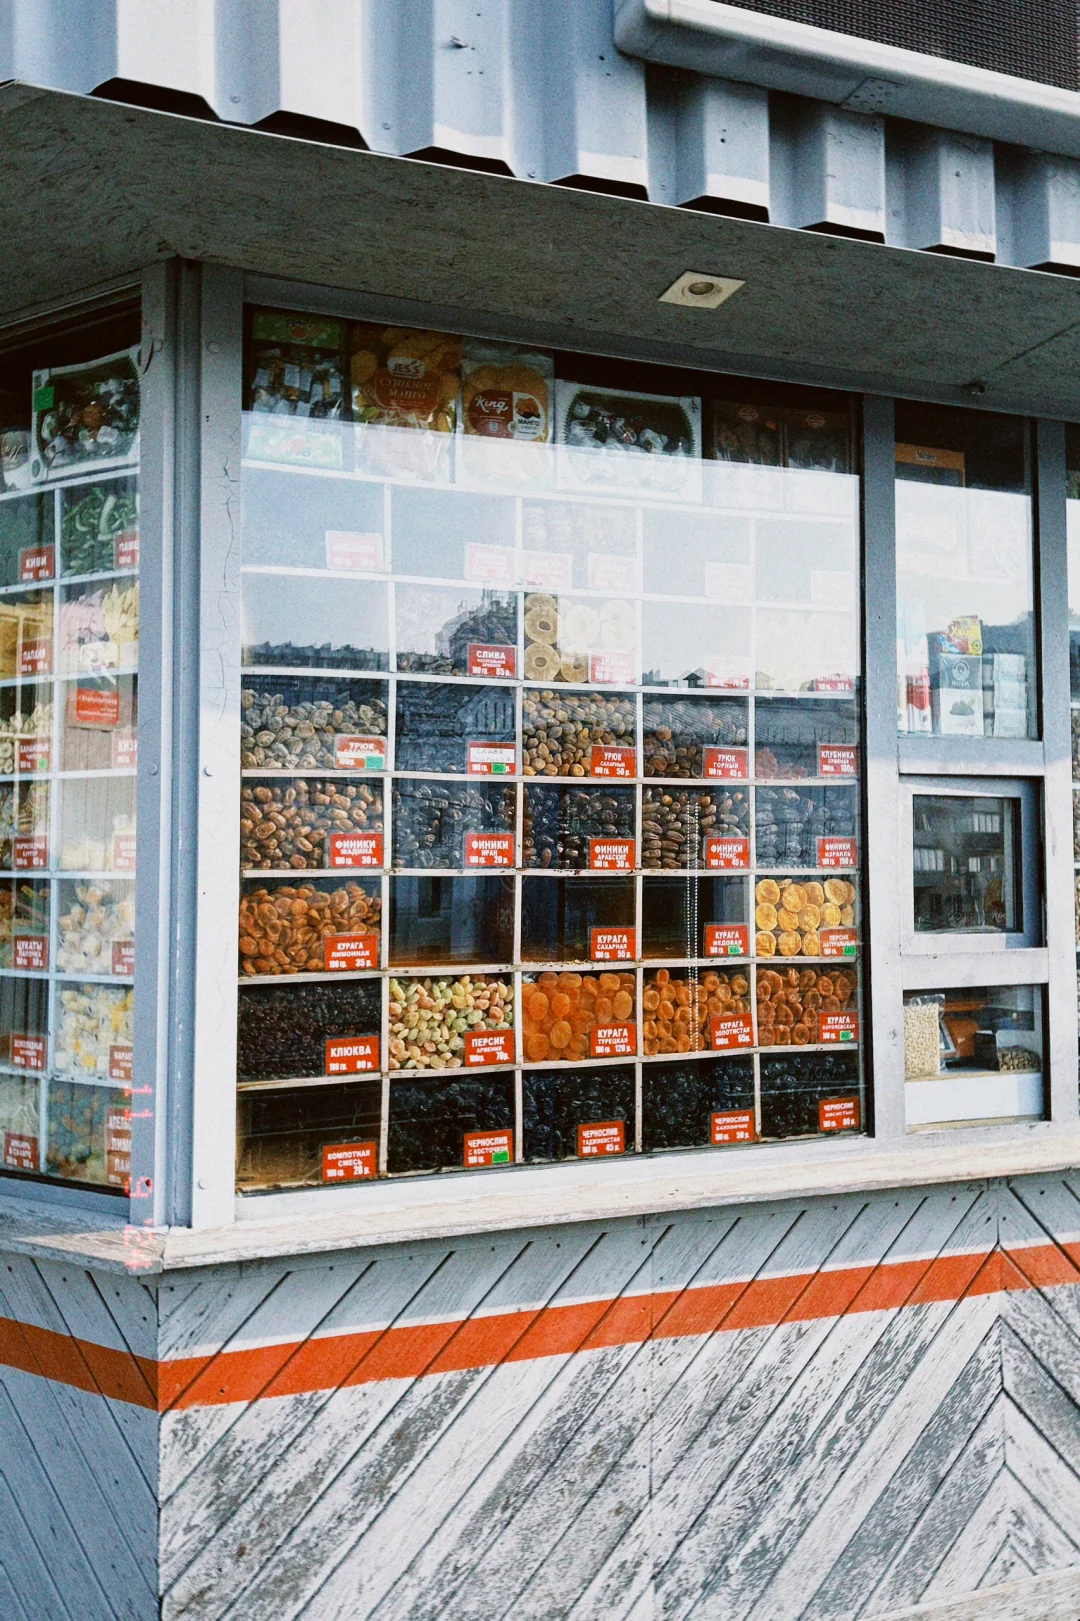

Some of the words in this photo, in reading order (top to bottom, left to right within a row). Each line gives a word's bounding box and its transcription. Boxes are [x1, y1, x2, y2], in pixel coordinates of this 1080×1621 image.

[389, 389, 425, 399] МАНГО
[475, 395, 509, 414] King
[518, 419, 540, 427] МАНГО
[26, 556, 47, 569] КИВИ
[476, 650, 506, 659] СЛИВА
[472, 666, 481, 674] 100
[349, 742, 375, 750] УРЮК
[604, 752, 622, 762] УРЮК
[718, 754, 736, 762] УРЮК
[821, 750, 855, 759] КЛУБНИКА
[335, 839, 376, 850] ФИНИКИ
[471, 840, 509, 850] ФИНИКИ
[710, 844, 743, 853] ФИНИКИ
[825, 843, 851, 851] ФИНИКИ
[481, 849, 498, 857] ИРАН
[594, 845, 629, 854] ФИНИКИ
[335, 857, 345, 865] 100
[469, 856, 479, 864] 100
[597, 853, 626, 861] АРАБСКИЕ
[594, 860, 602, 868] 100
[597, 934, 628, 943] КУРАГА
[715, 931, 740, 939] КУРАГА
[16, 941, 42, 951] ЦУКАТЫ
[337, 942, 364, 950] КУРАГА
[709, 946, 718, 954] 100
[331, 950, 370, 958] ЛИМОННАЯ
[595, 951, 604, 959] 100
[329, 960, 339, 968] 100
[720, 1020, 744, 1030] КУРАГА
[827, 1016, 851, 1025] КУРАГА
[597, 1028, 629, 1038] КУРАГА
[714, 1027, 751, 1037] ЗОЛОТИСТАЯ
[471, 1036, 505, 1048] ПЕРСИК
[597, 1037, 629, 1045] ТУРЕЦКАЯ
[330, 1045, 372, 1058] КЛЮКВА
[595, 1046, 605, 1054] 100
[329, 1063, 340, 1071] 100
[823, 1102, 854, 1112] ЧЕРНОСЛИВ
[714, 1115, 750, 1124] ЧЕРНОСЛИВ
[823, 1120, 831, 1128] 100
[582, 1127, 618, 1138] ЧЕРНОСЛИВ
[714, 1133, 723, 1141] 100
[468, 1136, 508, 1147] ЧЕРНОСЛИВ
[582, 1136, 620, 1146] ТАДЖИКИСТАН
[474, 1145, 508, 1155] КОСТОЧКОЙ
[582, 1145, 591, 1153] 100
[327, 1149, 371, 1160] КОМПОТНАЯ
[337, 1159, 363, 1167] СМЕСЬ
[468, 1156, 478, 1164] 100
[326, 1168, 337, 1178] 100
